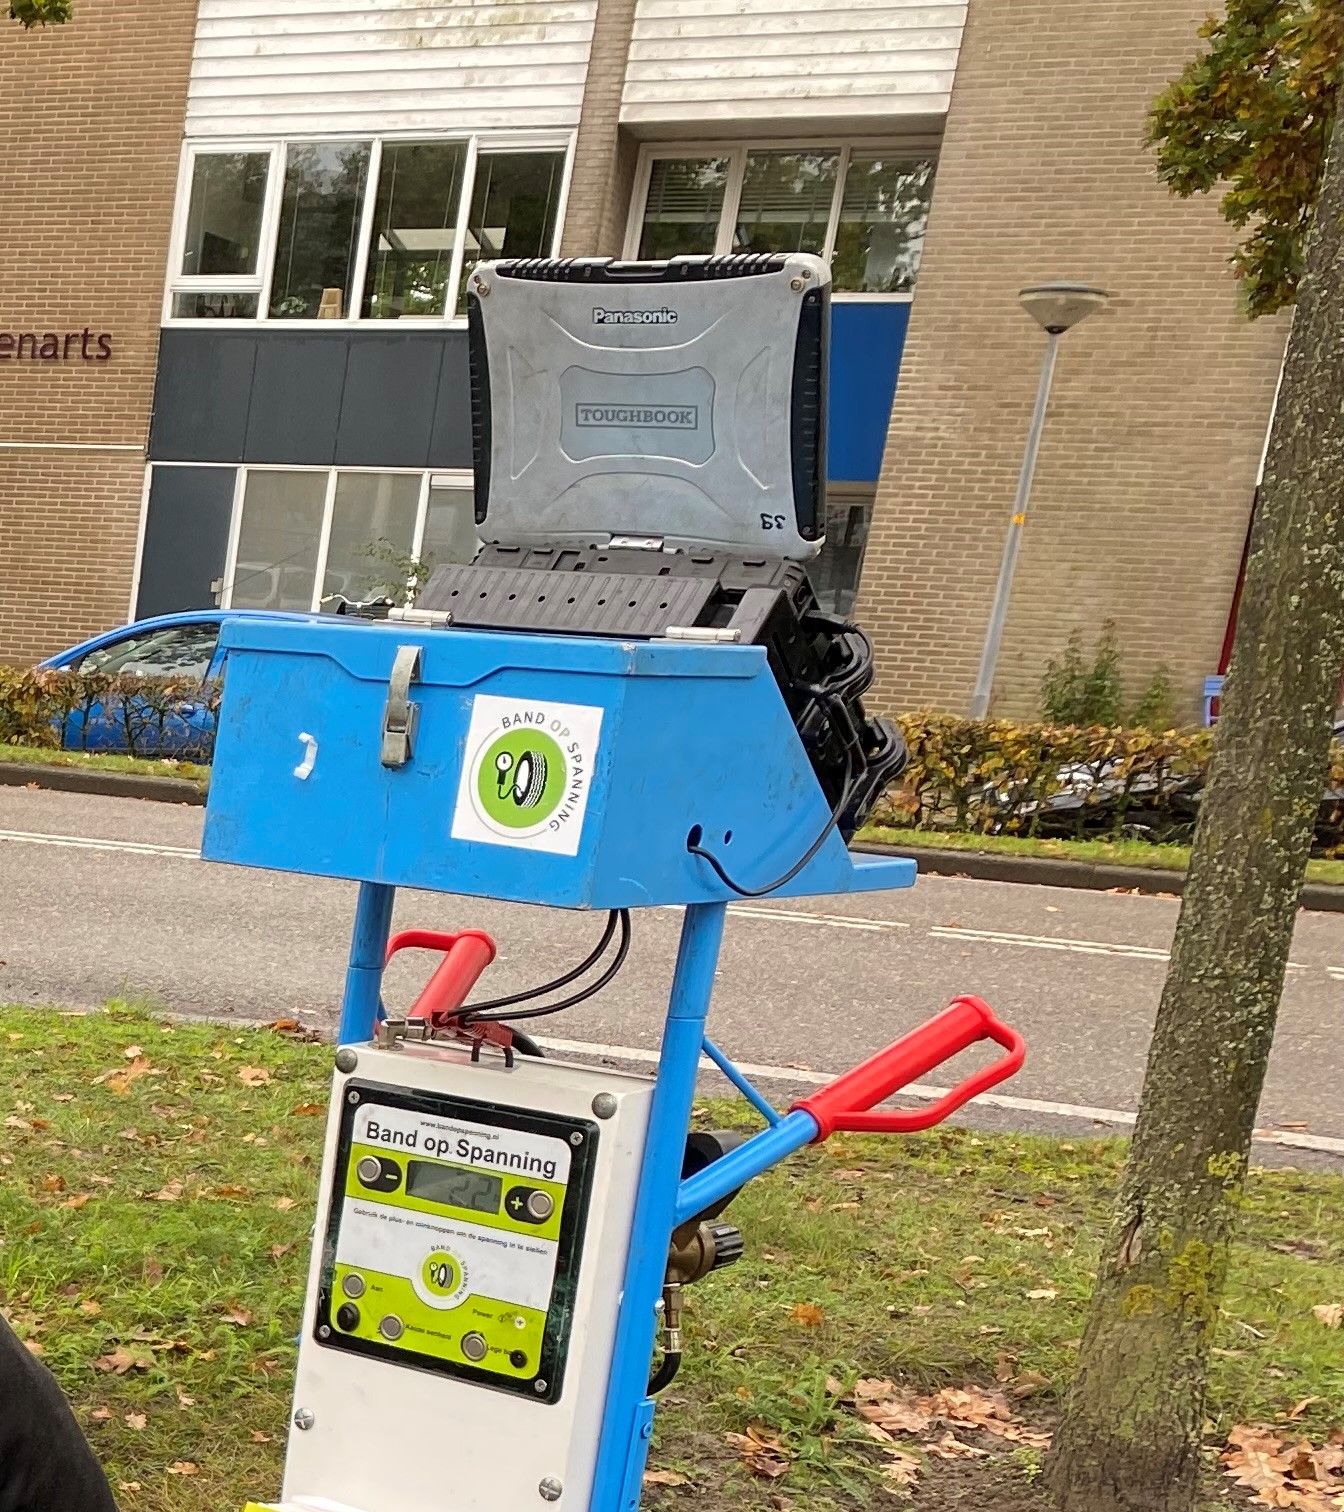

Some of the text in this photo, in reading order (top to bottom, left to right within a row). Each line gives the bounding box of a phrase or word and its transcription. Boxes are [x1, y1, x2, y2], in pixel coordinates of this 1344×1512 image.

[592, 307, 678, 324] Panasonic
[580, 408, 694, 425] TOUGHBOOK
[501, 711, 585, 833] BAND OP SPANNING
[366, 1120, 557, 1180] Band op Spanning
[472, 1308, 494, 1319] Power
